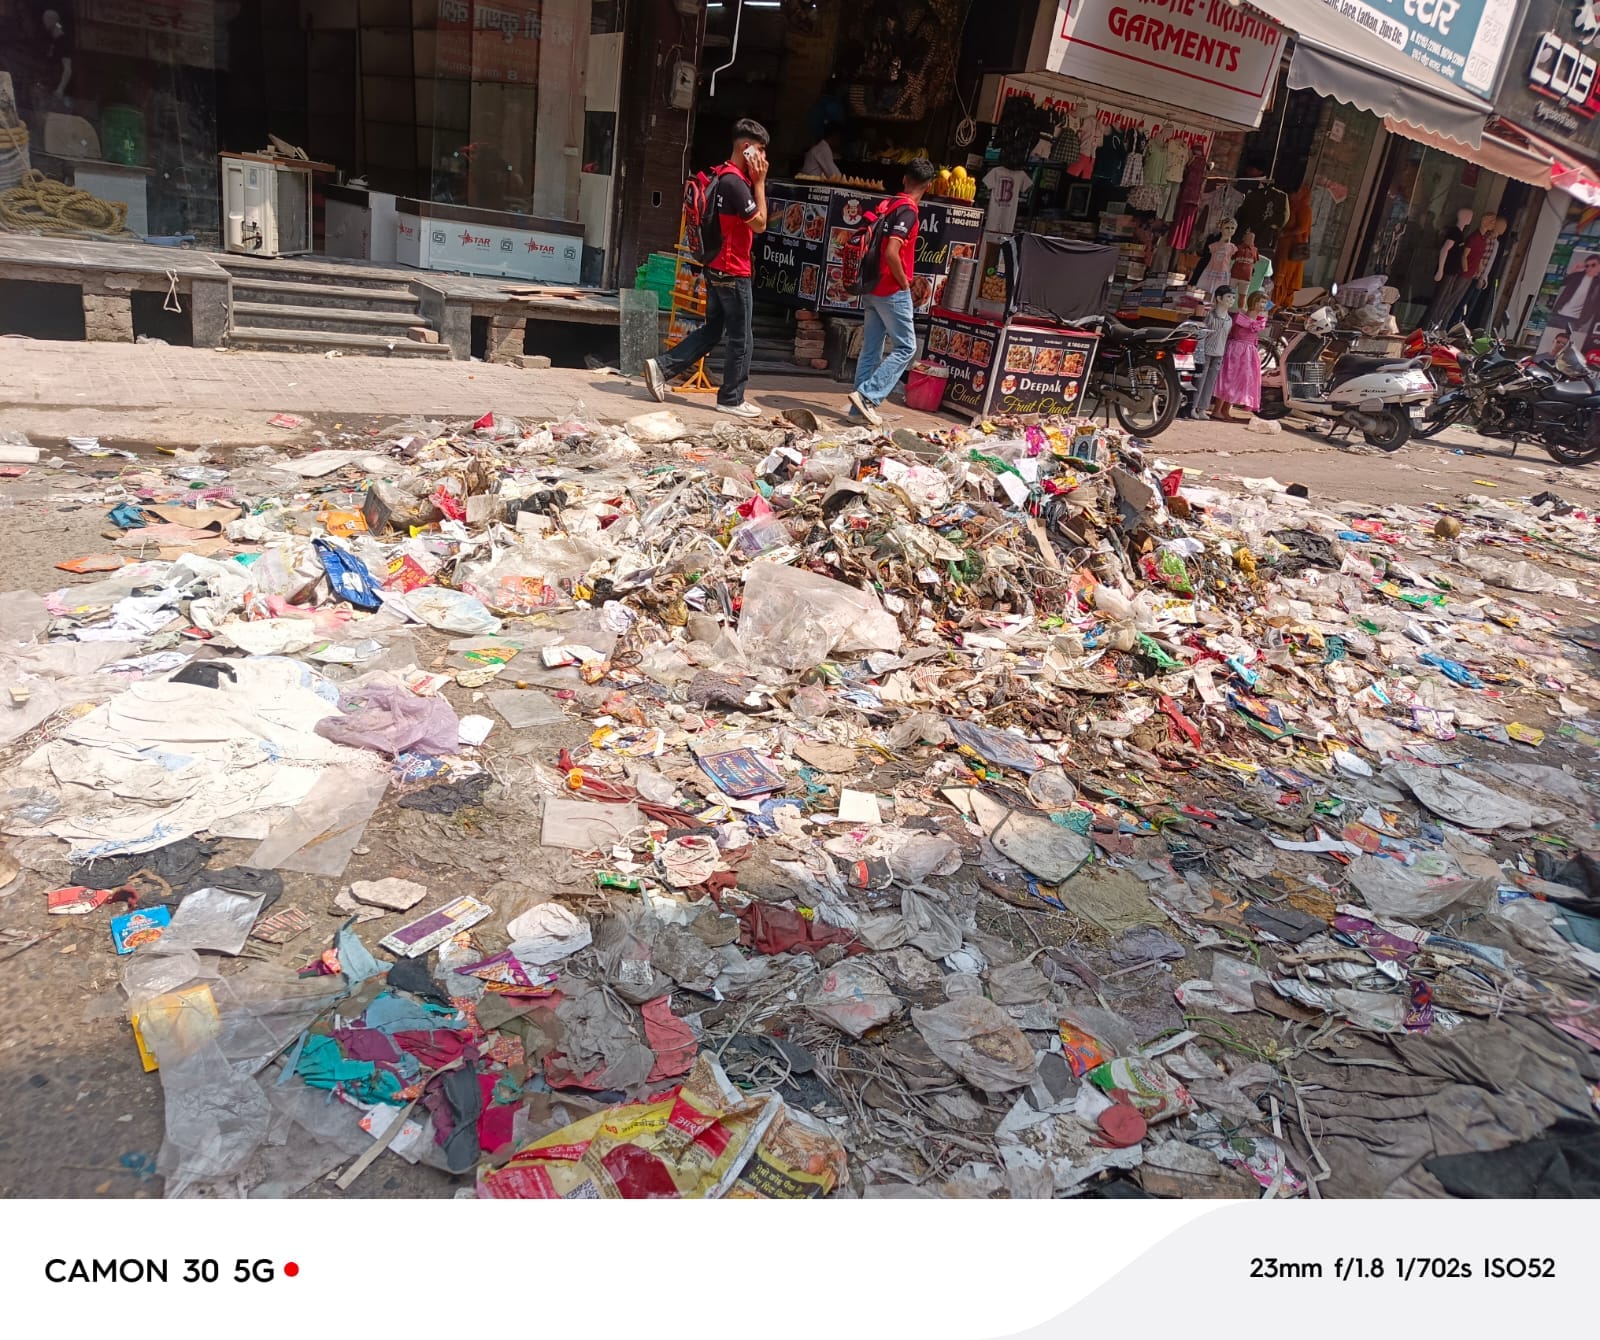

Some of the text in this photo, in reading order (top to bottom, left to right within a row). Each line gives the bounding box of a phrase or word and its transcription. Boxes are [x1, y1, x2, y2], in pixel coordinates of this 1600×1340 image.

[1108, 6, 1241, 72] GARMENTS
[1391, 26, 1402, 45] Etc.
[998, 395, 1074, 415] Fruit Chaat
